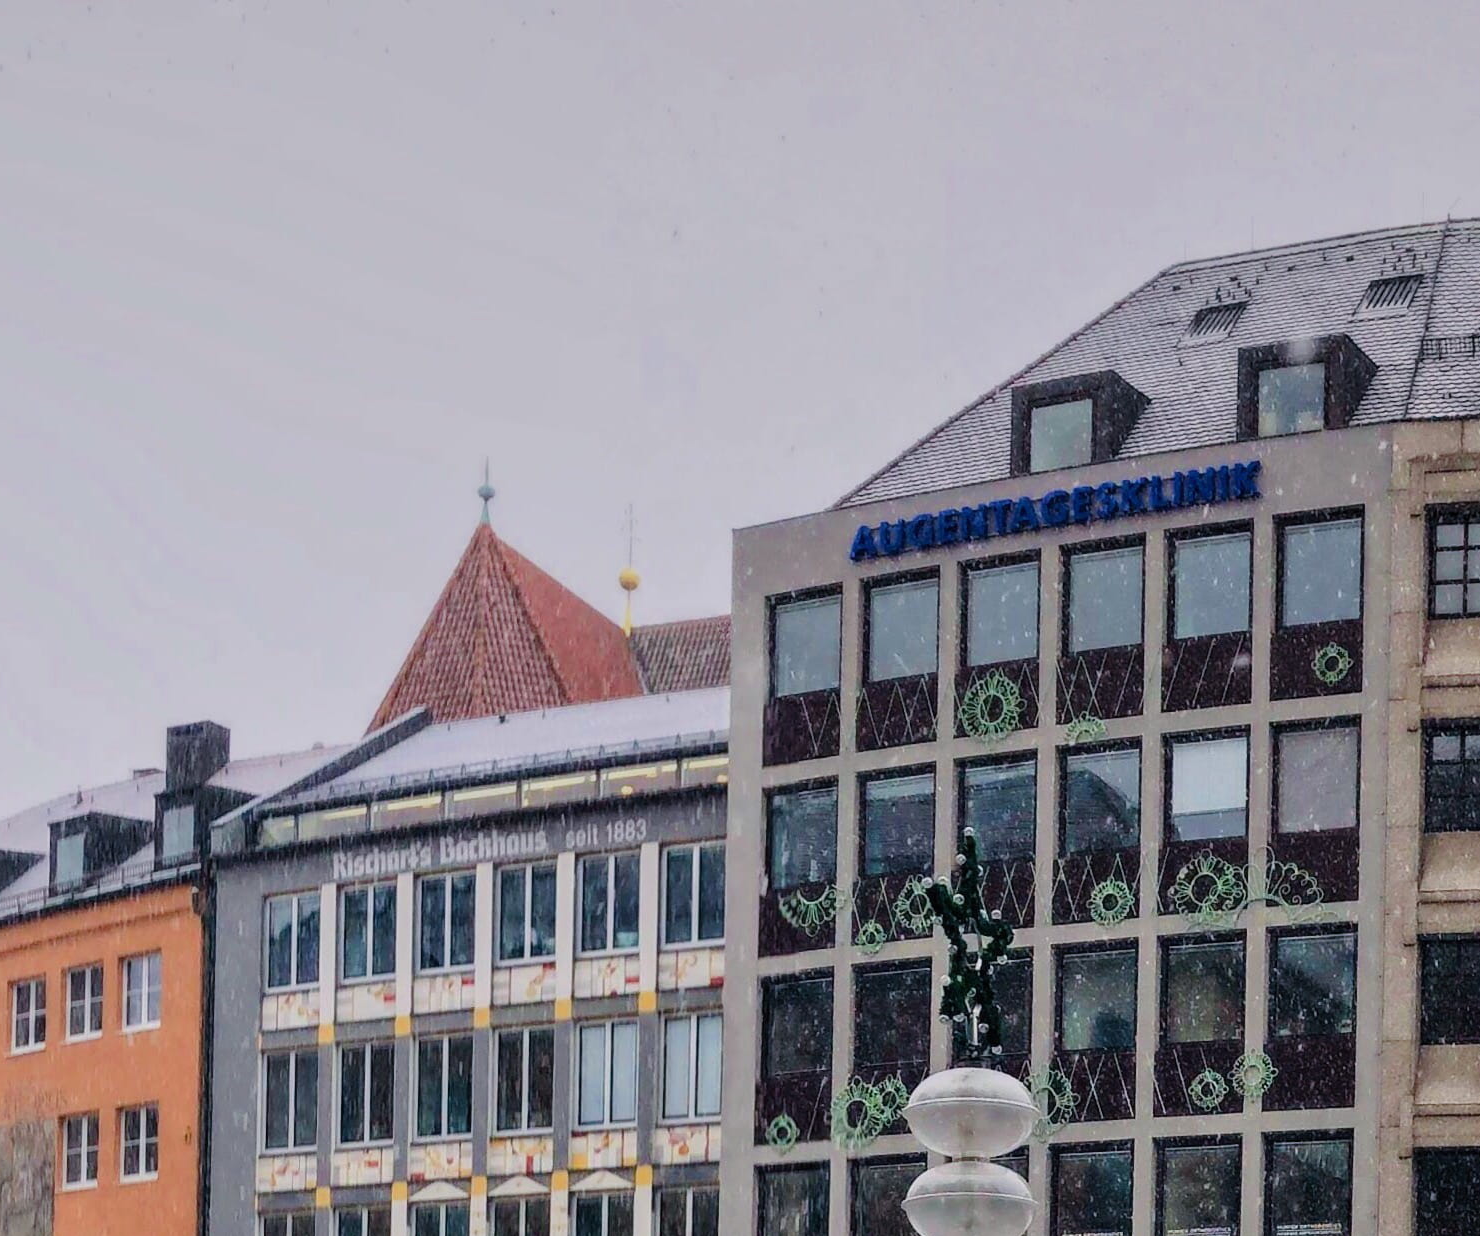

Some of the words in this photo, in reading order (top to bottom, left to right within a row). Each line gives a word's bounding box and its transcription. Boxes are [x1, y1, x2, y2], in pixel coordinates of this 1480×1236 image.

[850, 460, 1262, 562] AUGENTAGESKLINIK
[440, 829, 547, 866] Backhaus
[566, 822, 598, 849] seit
[607, 818, 647, 844] 1883
